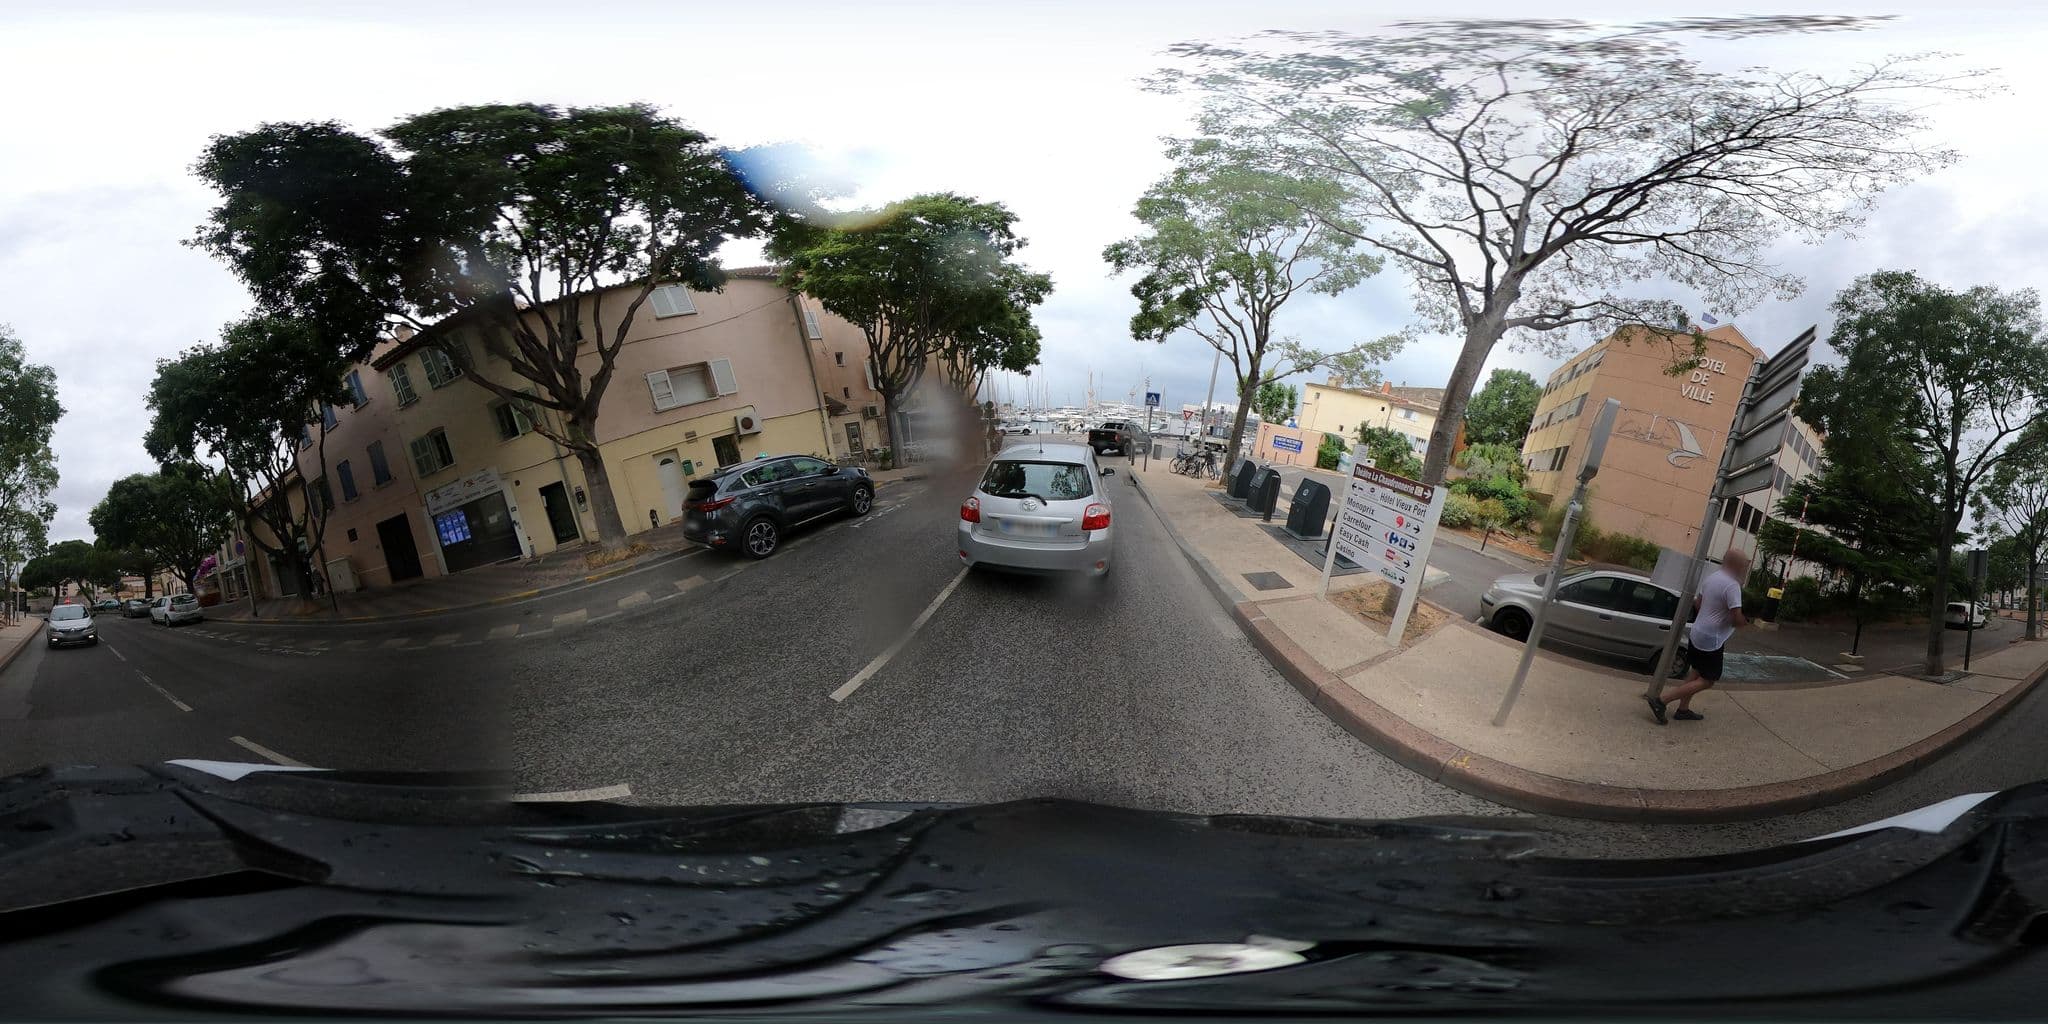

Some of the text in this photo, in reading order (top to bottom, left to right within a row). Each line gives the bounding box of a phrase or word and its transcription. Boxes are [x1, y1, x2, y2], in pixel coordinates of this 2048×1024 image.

[1690, 370, 1710, 386] DE
[1681, 383, 1715, 404] VILLE
[1346, 497, 1375, 516] Monoprix
[1380, 492, 1427, 518] Hôtel Vieux Port
[1343, 512, 1371, 532] Carrefour
[1339, 527, 1370, 549] Easy Cash
[1336, 541, 1355, 558] Casino
